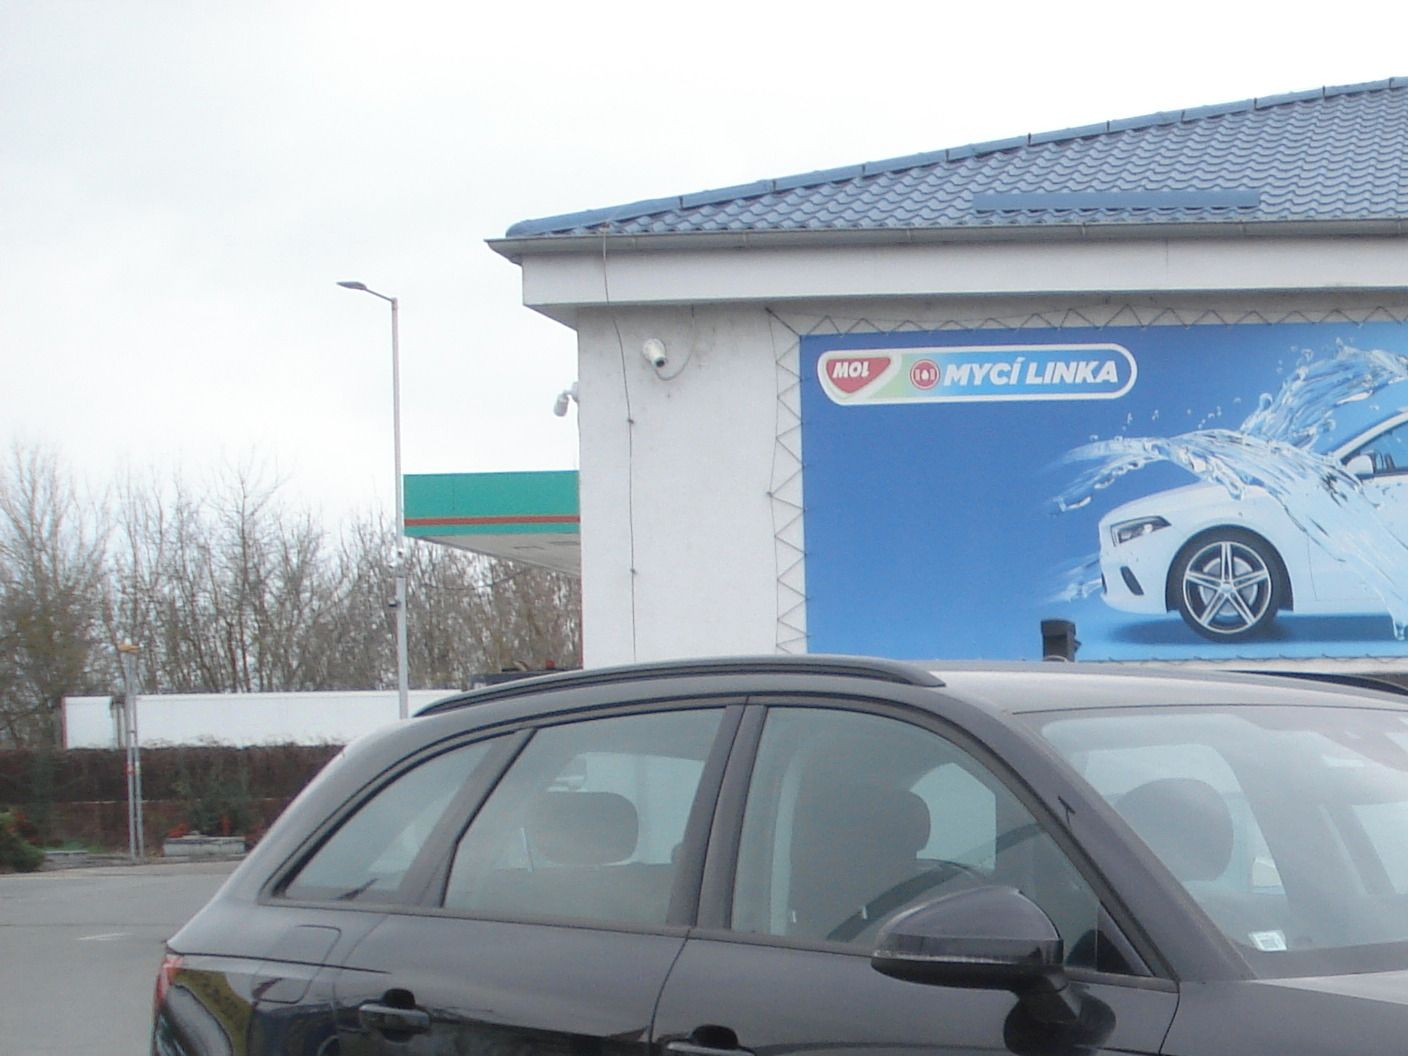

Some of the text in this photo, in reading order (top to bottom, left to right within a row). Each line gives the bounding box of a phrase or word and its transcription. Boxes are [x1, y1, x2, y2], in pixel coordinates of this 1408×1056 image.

[832, 361, 870, 379] MOL
[944, 357, 1118, 386] MYCÍ LINKA
